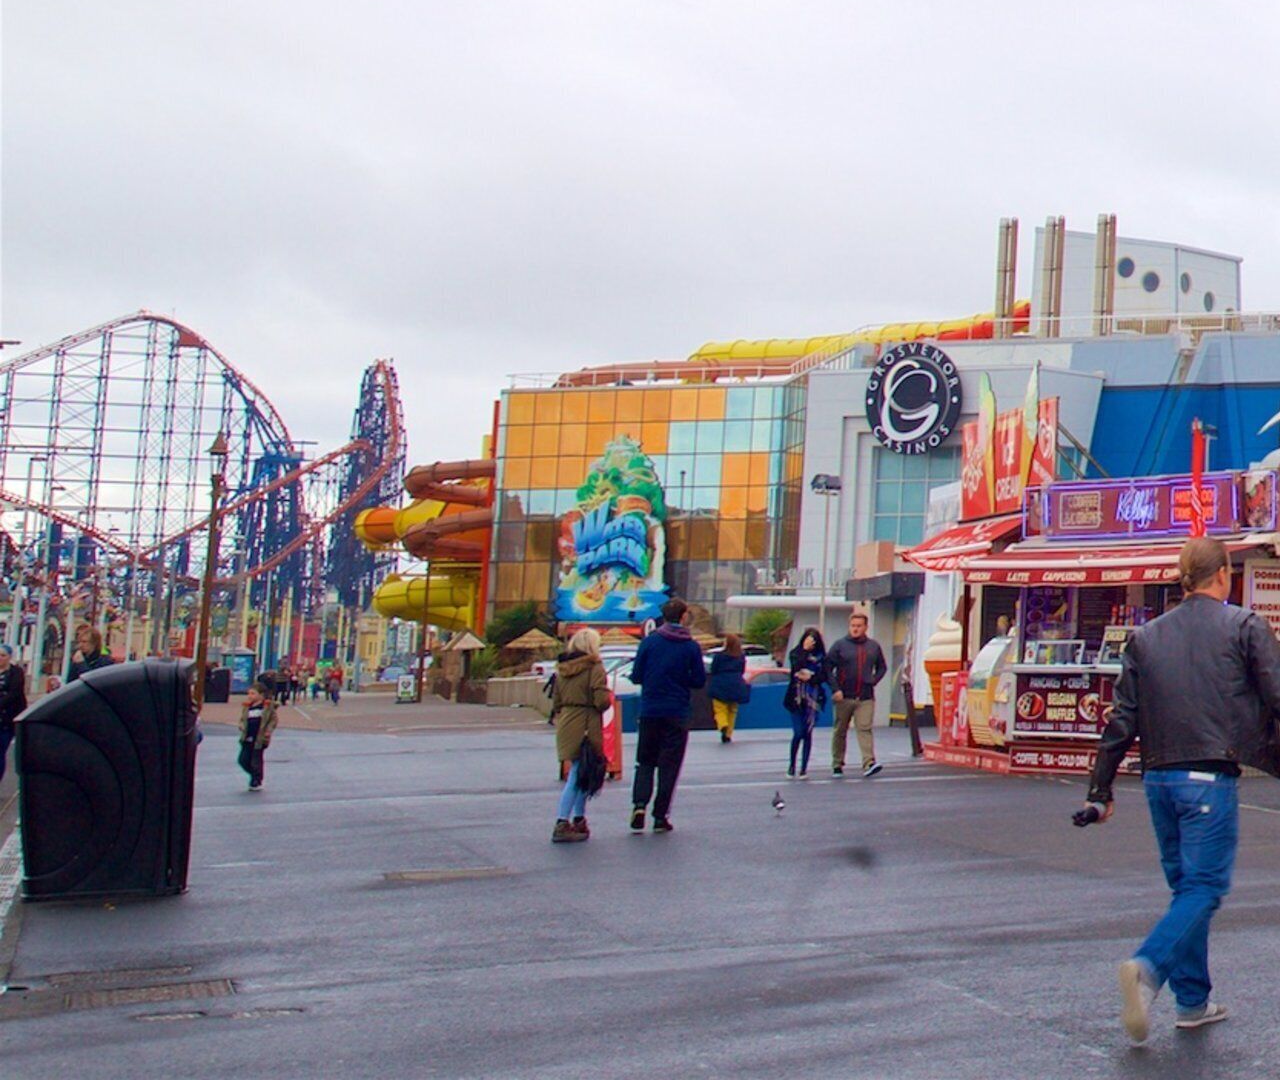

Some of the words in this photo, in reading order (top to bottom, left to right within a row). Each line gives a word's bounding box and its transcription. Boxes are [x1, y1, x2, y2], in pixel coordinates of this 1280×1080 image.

[868, 343, 958, 391] GROSVENOR
[874, 424, 949, 454] CASINOS
[572, 500, 647, 553] WATER
[578, 536, 648, 577] PARK
[1047, 693, 1077, 706] BELGIAN
[1015, 753, 1039, 764] COFFEE
[1042, 753, 1054, 765] TEA
[1057, 754, 1075, 766] COLD
